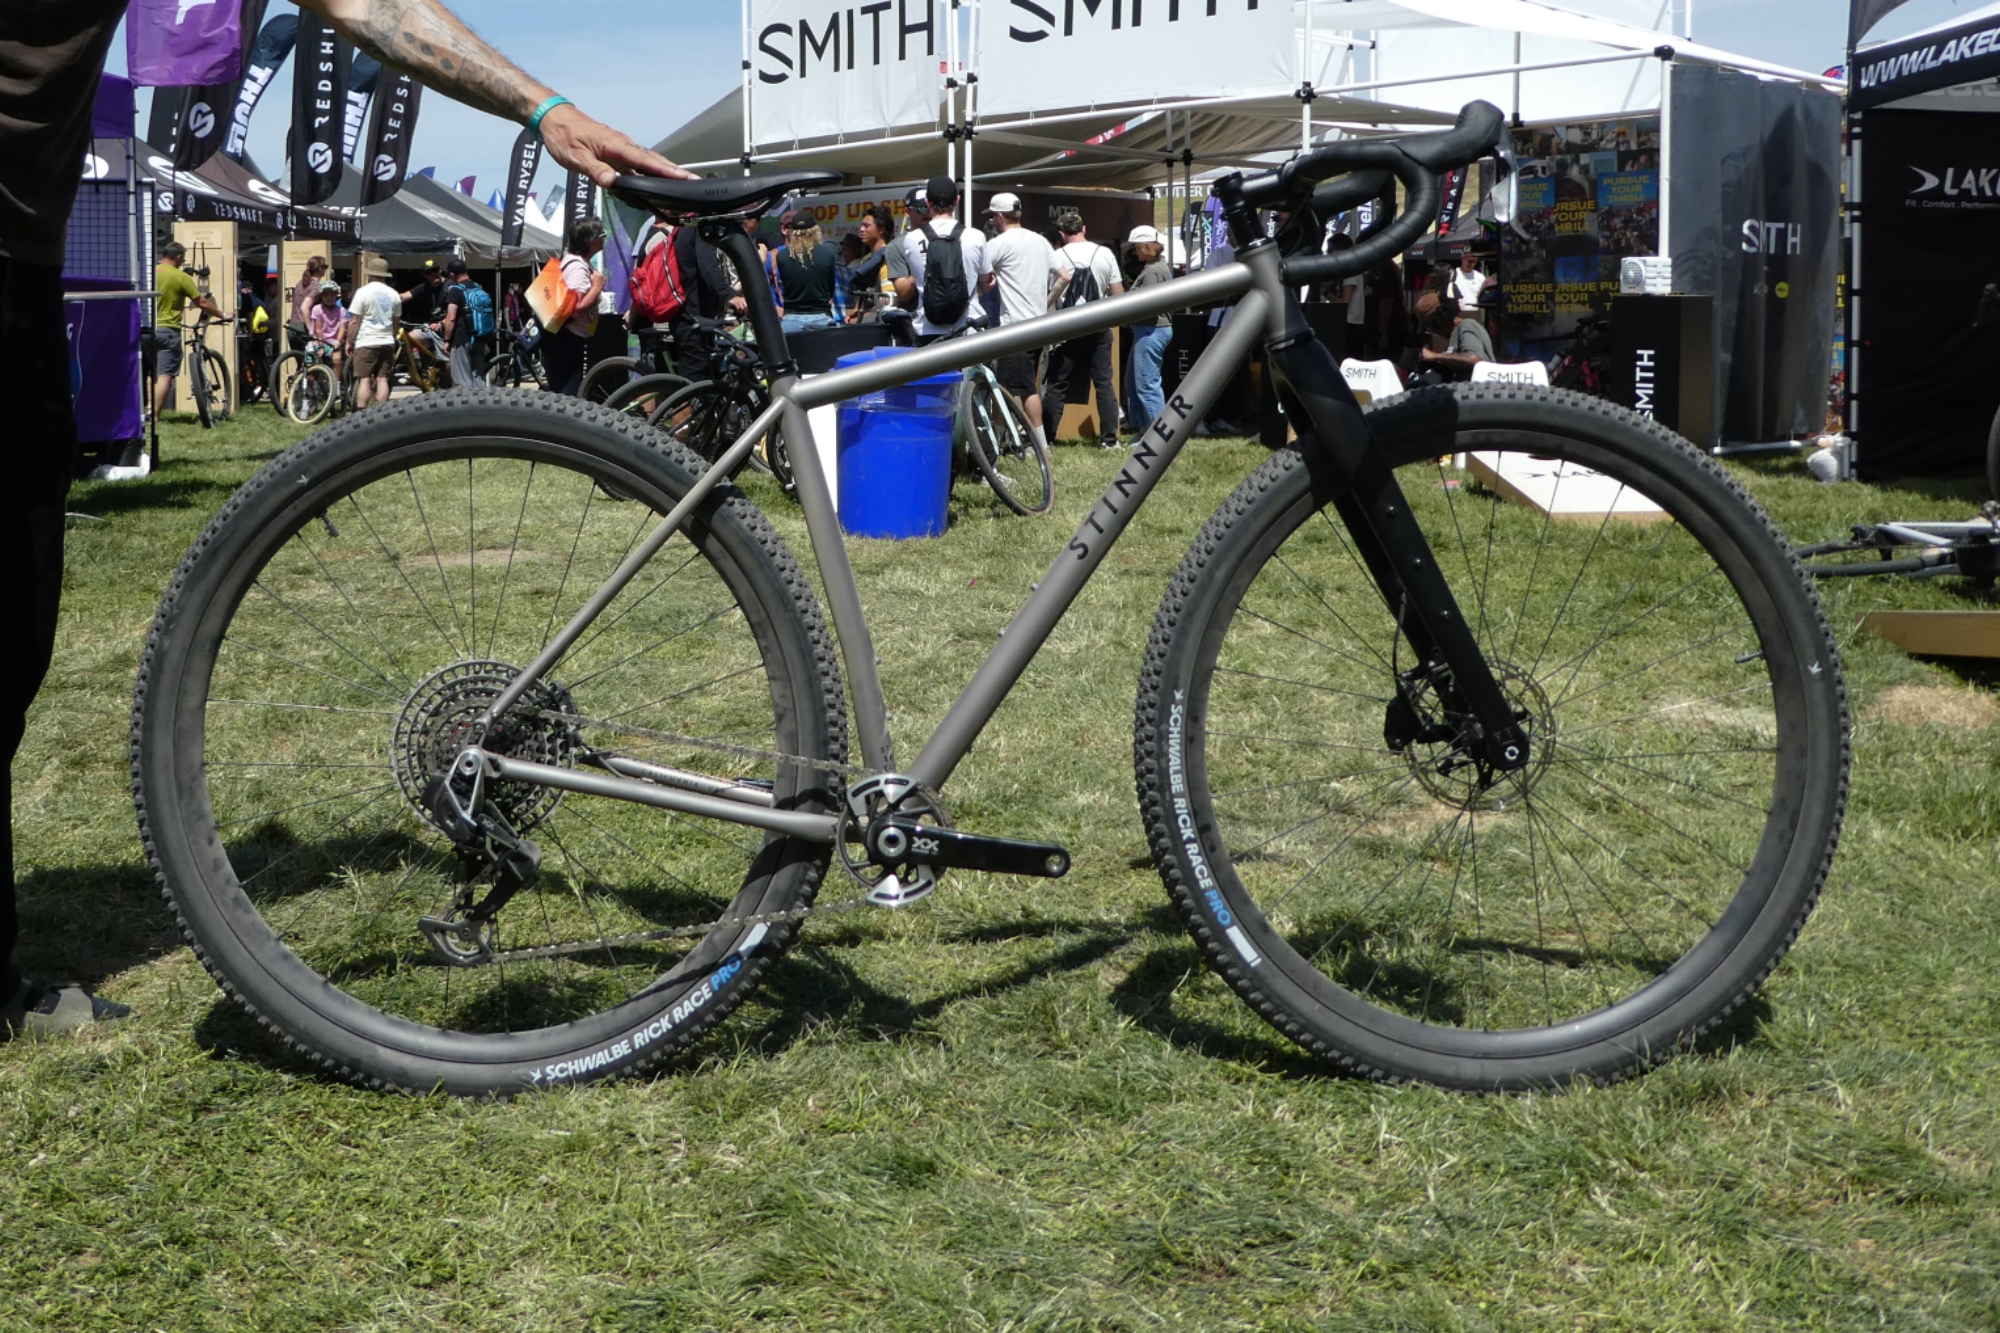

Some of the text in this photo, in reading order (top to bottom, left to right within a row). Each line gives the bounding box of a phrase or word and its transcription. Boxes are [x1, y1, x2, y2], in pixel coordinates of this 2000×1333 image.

[758, 0, 934, 84] SMITH
[315, 28, 335, 129] REDSHI
[384, 74, 411, 142] REDSH
[512, 140, 537, 227] VAN RYSEL
[1520, 182, 1549, 191] RSUE
[1603, 175, 1650, 186] PURSUE
[1943, 167, 2000, 196] LAK
[575, 173, 589, 220] AN RYS
[1446, 175, 1460, 209] RAC
[1611, 185, 1643, 194] YOUR
[1554, 200, 1596, 212] URSUE
[1607, 194, 1646, 204] THRILL
[212, 202, 263, 224] REDSHIFT
[307, 215, 347, 232] REDSHIFT
[1554, 222, 1592, 232] HRILL
[1502, 284, 1553, 293] PURSUE
[1555, 283, 1597, 292] URSUE
[1510, 294, 1545, 303] YOUR
[1506, 304, 1549, 313] THRILL
[1555, 303, 1593, 313] HRILL
[1179, 349, 1189, 380] ITH
[1344, 367, 1377, 379] SMITH
[1487, 371, 1534, 385] SMITH
[1069, 394, 1194, 561] STINNER
[1168, 704, 1232, 926] SCHWALBE RICK RACE PRO
[545, 956, 742, 1081] SCHWALBE RICK RACE PRO
